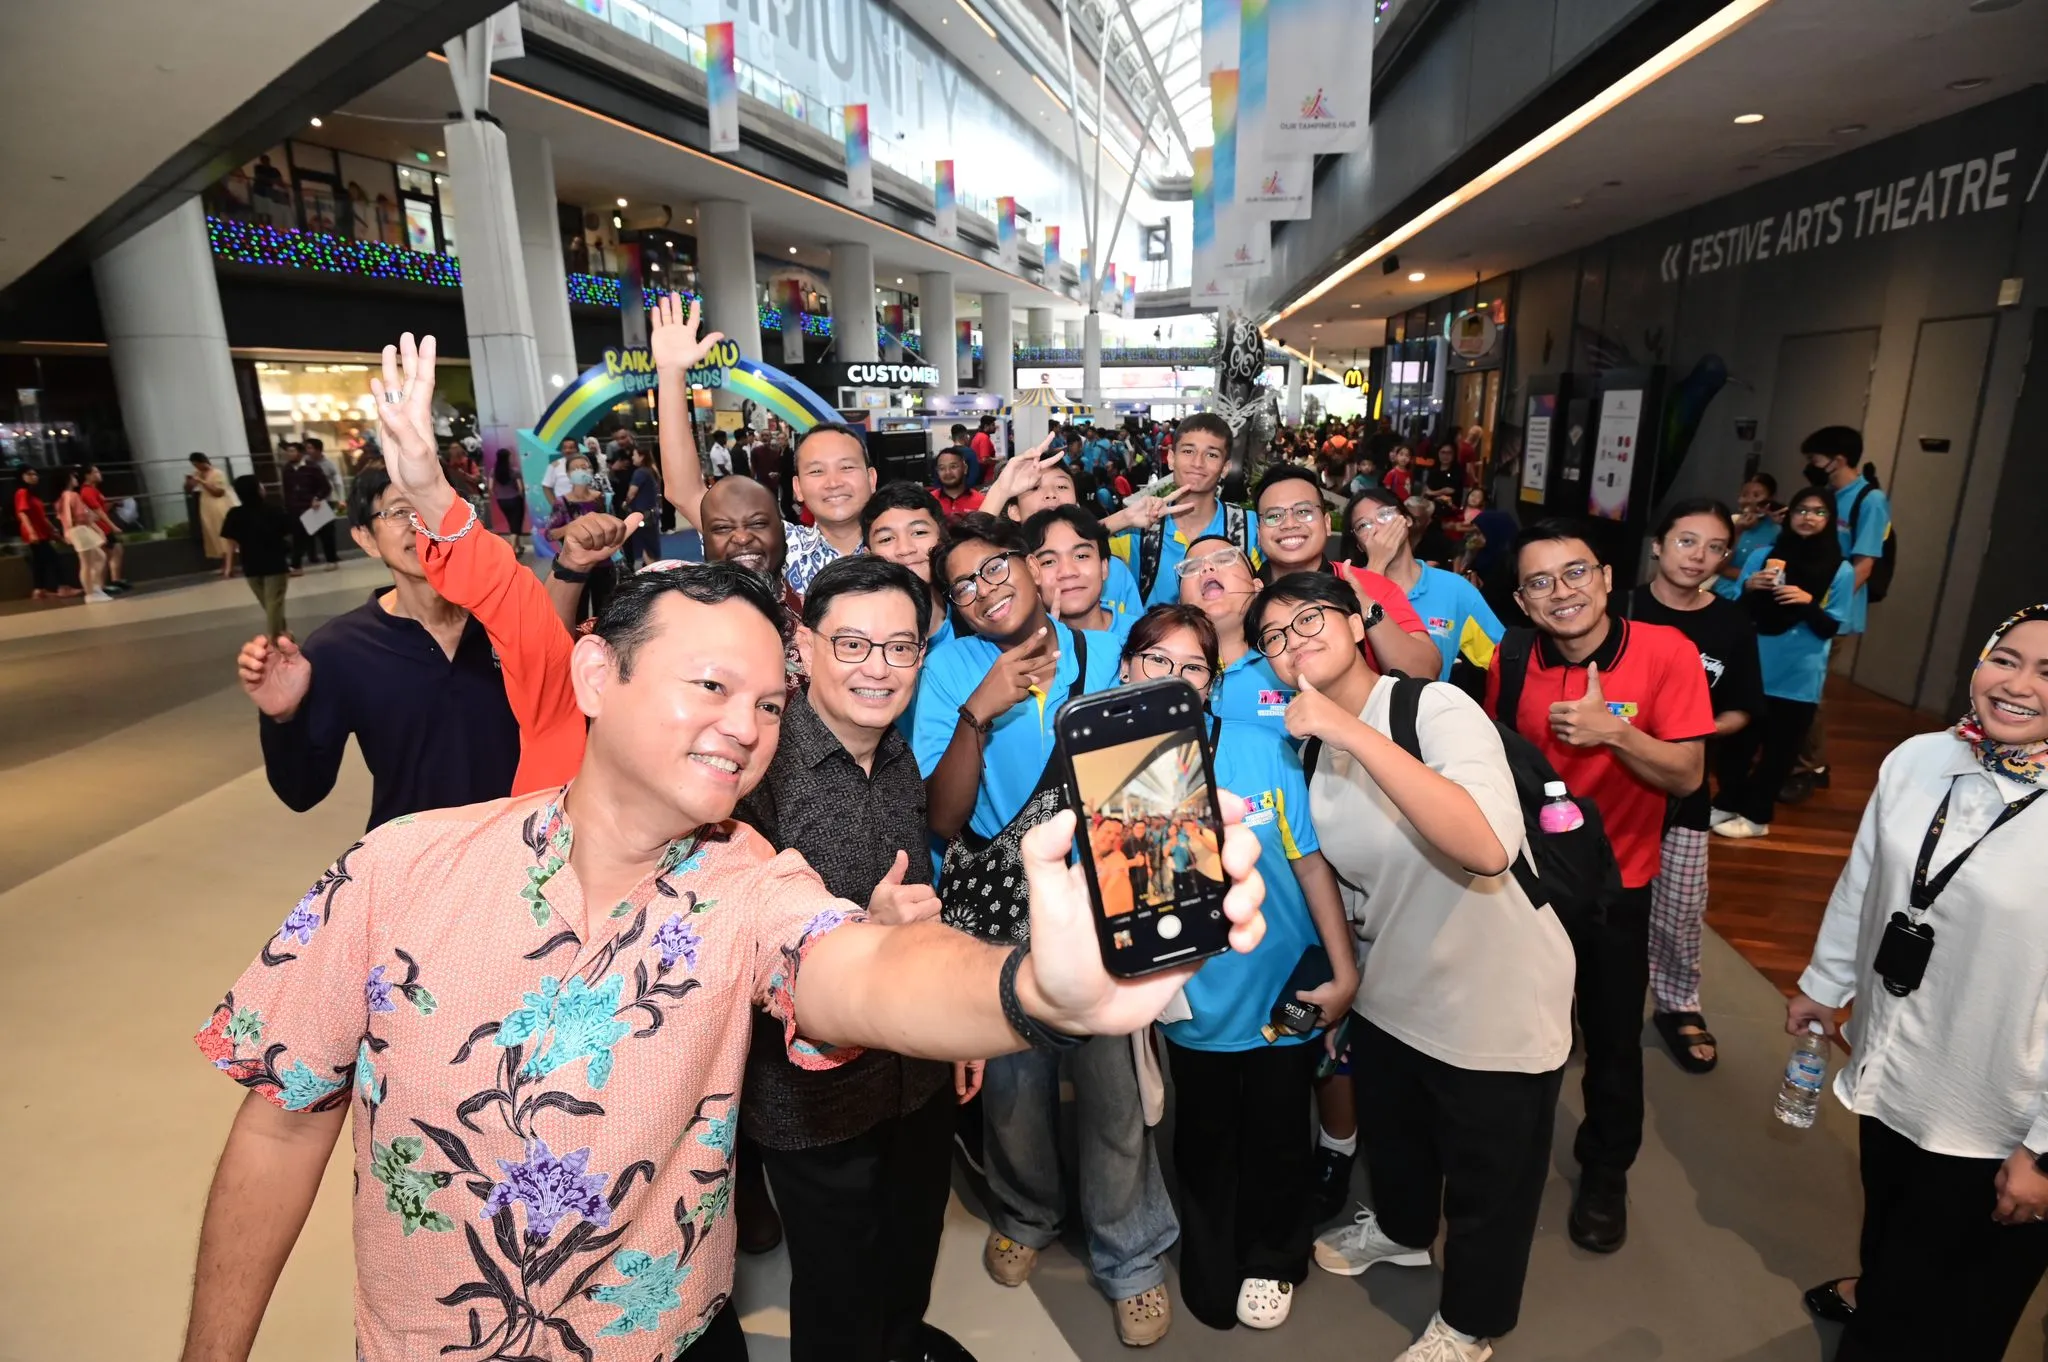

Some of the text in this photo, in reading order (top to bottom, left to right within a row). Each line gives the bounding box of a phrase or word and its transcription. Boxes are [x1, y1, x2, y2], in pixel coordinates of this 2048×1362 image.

[1688, 217, 1774, 275] FESTIVE
[1776, 196, 1847, 255] ARTS
[1853, 148, 2017, 239] THEATRE
